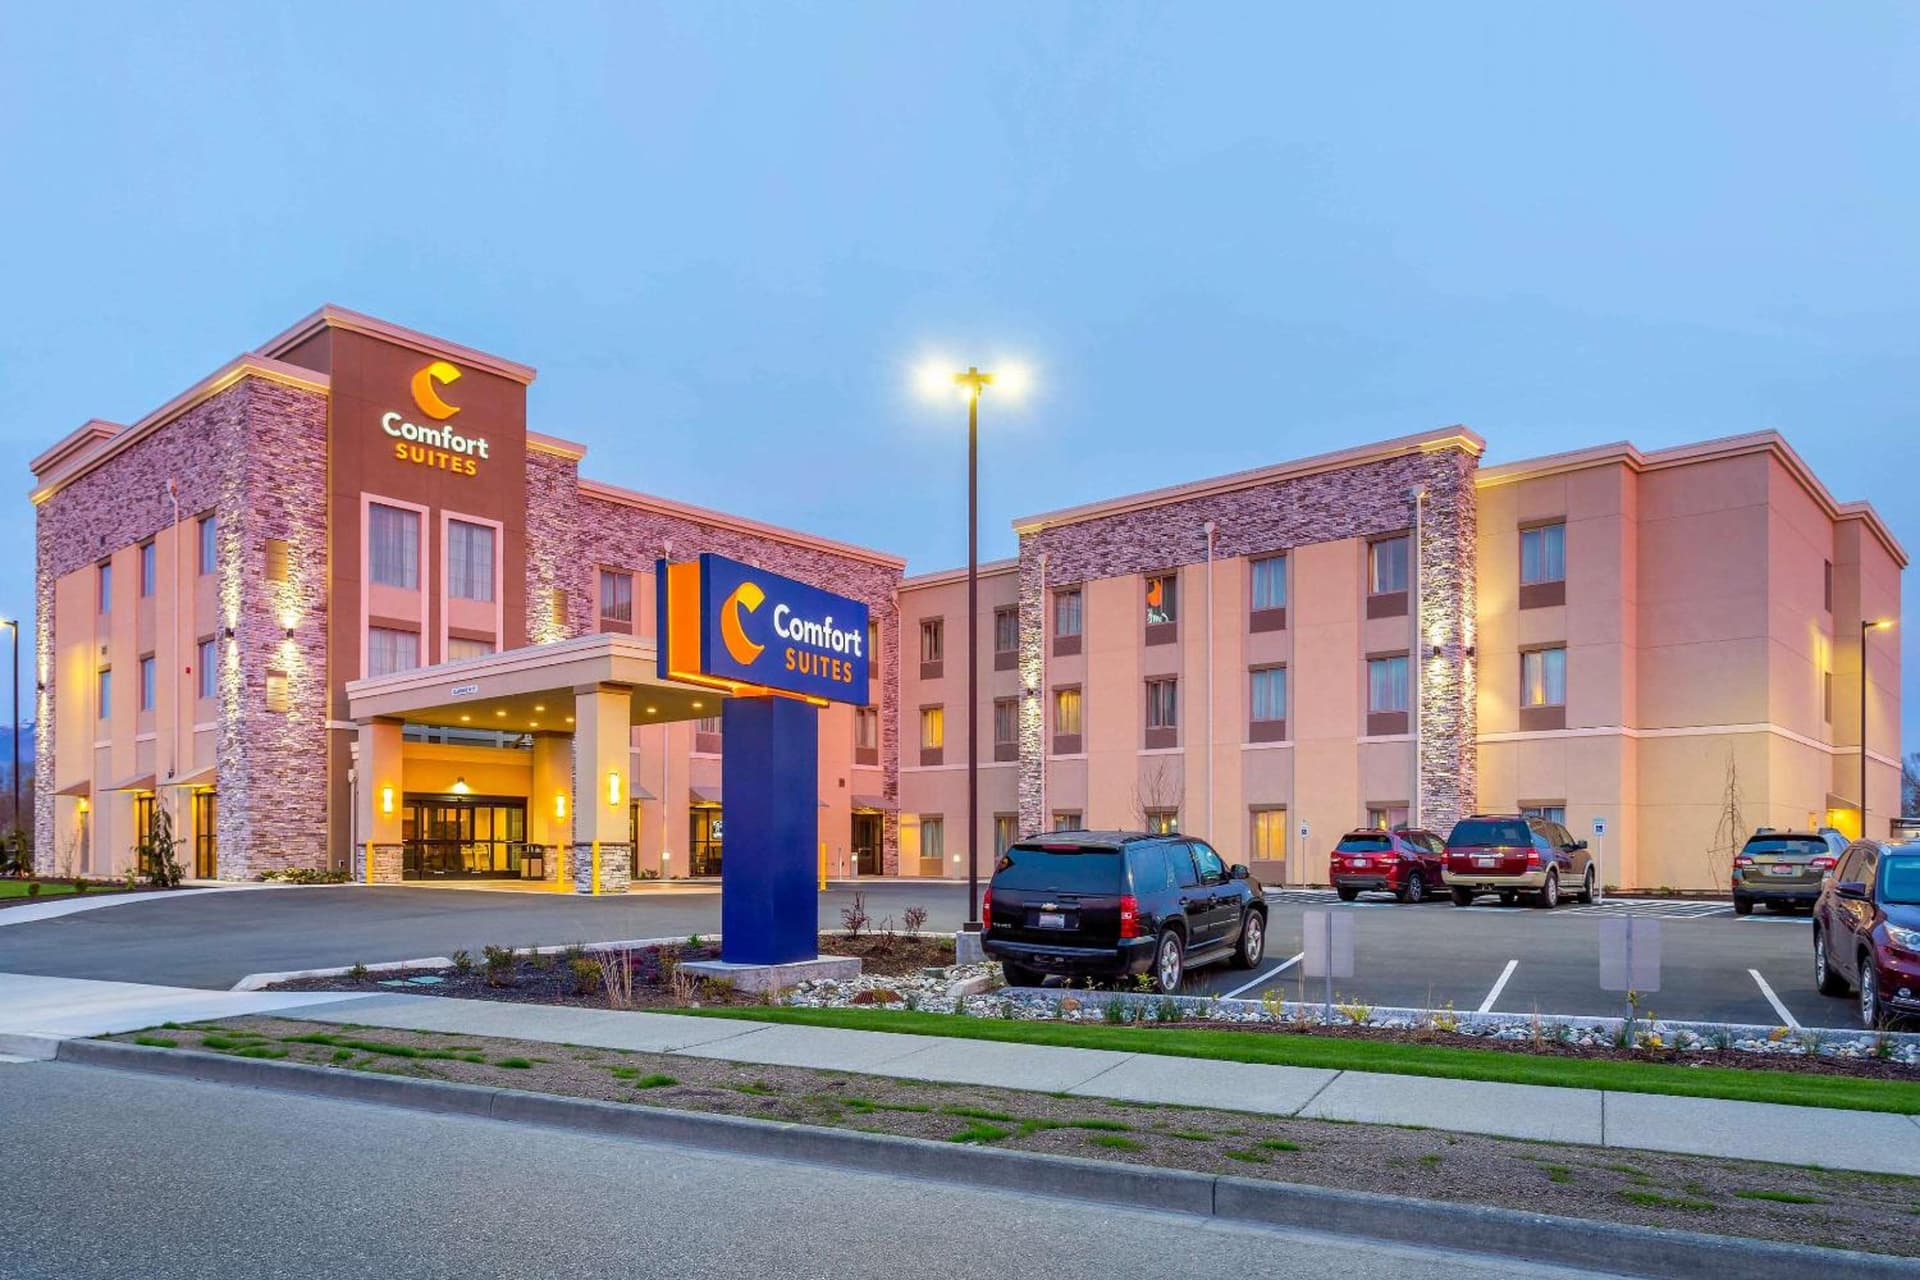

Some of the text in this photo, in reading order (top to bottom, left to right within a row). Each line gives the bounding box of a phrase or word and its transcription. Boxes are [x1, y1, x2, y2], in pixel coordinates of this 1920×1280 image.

[382, 411, 488, 459] Comfort
[395, 442, 477, 476] SUITES
[774, 604, 862, 657] Comfort
[785, 647, 852, 683] SUITES
